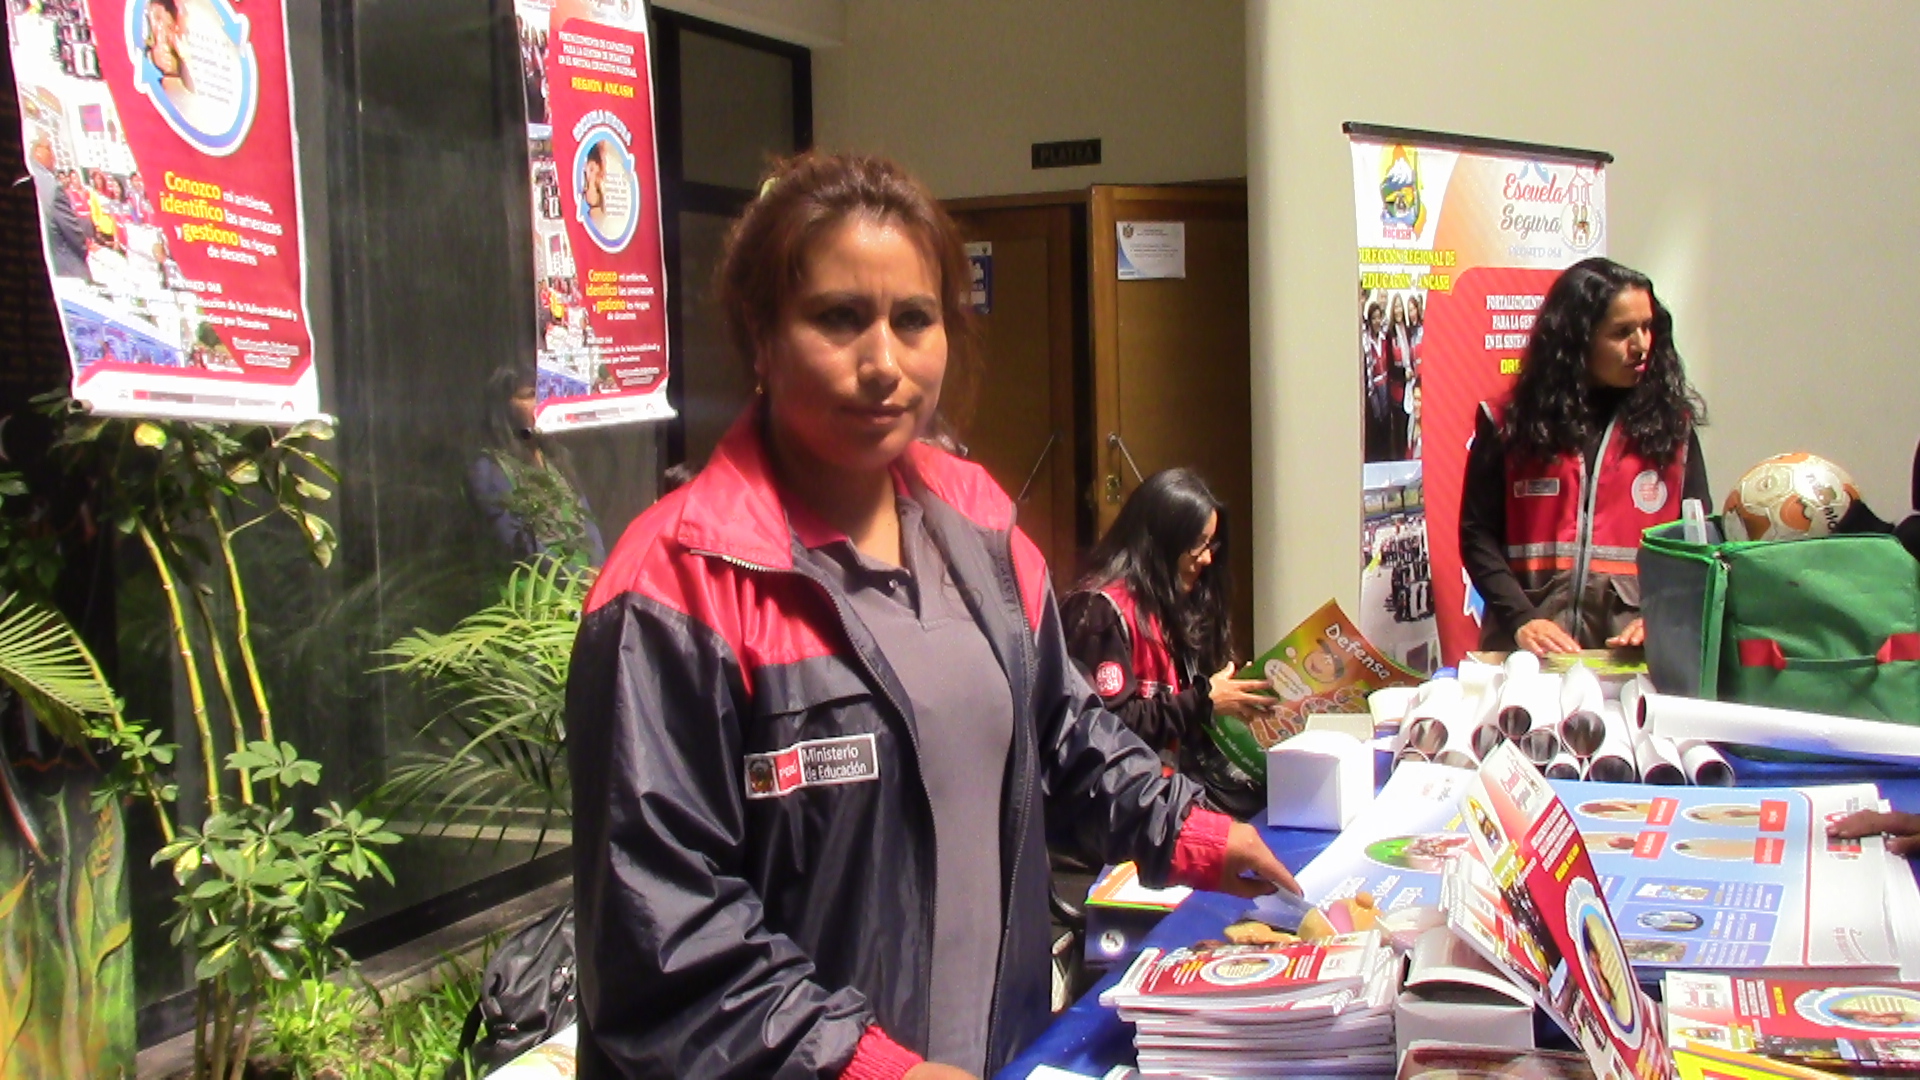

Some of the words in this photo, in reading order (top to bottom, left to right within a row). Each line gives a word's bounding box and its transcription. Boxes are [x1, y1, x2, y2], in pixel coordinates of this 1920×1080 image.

[164, 171, 222, 200] Conozco
[1503, 173, 1563, 204] Escuela
[159, 191, 224, 222] identifico
[1500, 203, 1561, 240] Segura
[182, 222, 239, 246] gestiono
[1403, 249, 1443, 266] REGIONAL
[1445, 250, 1456, 266] DE
[588, 269, 618, 282] Conozco
[1417, 274, 1450, 290] ANCASH
[1492, 315, 1510, 330] PARA
[1511, 315, 1520, 330] LA
[1324, 621, 1391, 681] Defensa
[803, 743, 859, 764] Ministerio
[778, 759, 799, 780] PERÚ
[805, 767, 817, 781] de
[818, 760, 868, 780] Educación
